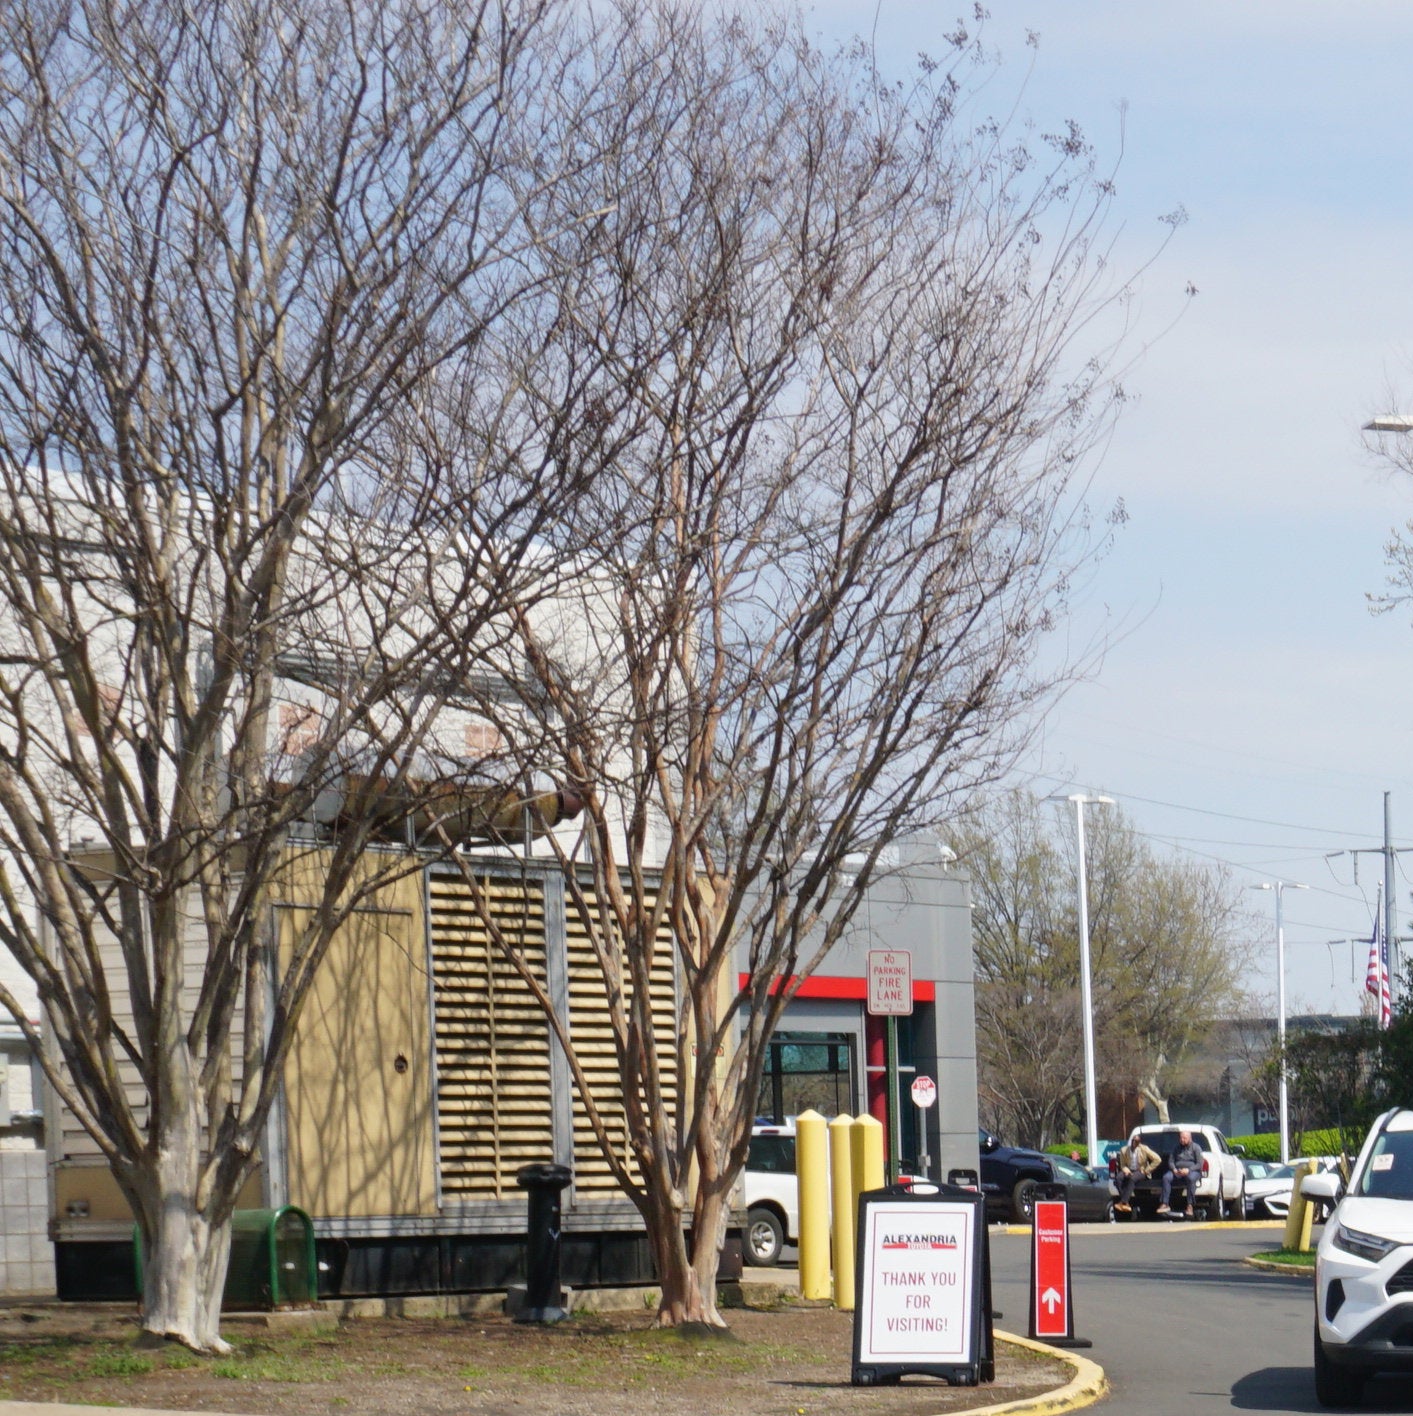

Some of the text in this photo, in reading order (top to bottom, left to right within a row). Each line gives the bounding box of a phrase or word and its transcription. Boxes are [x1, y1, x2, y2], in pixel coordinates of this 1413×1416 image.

[884, 956, 895, 964] NO
[873, 966, 906, 976] PARKING
[879, 977, 901, 988] FIRE
[877, 990, 903, 1001] LANE
[883, 1234, 957, 1244] ALEXANDRIA
[882, 1271, 956, 1287] THANK YOU
[905, 1294, 931, 1309] FOR
[887, 1317, 948, 1332] VISITING!
